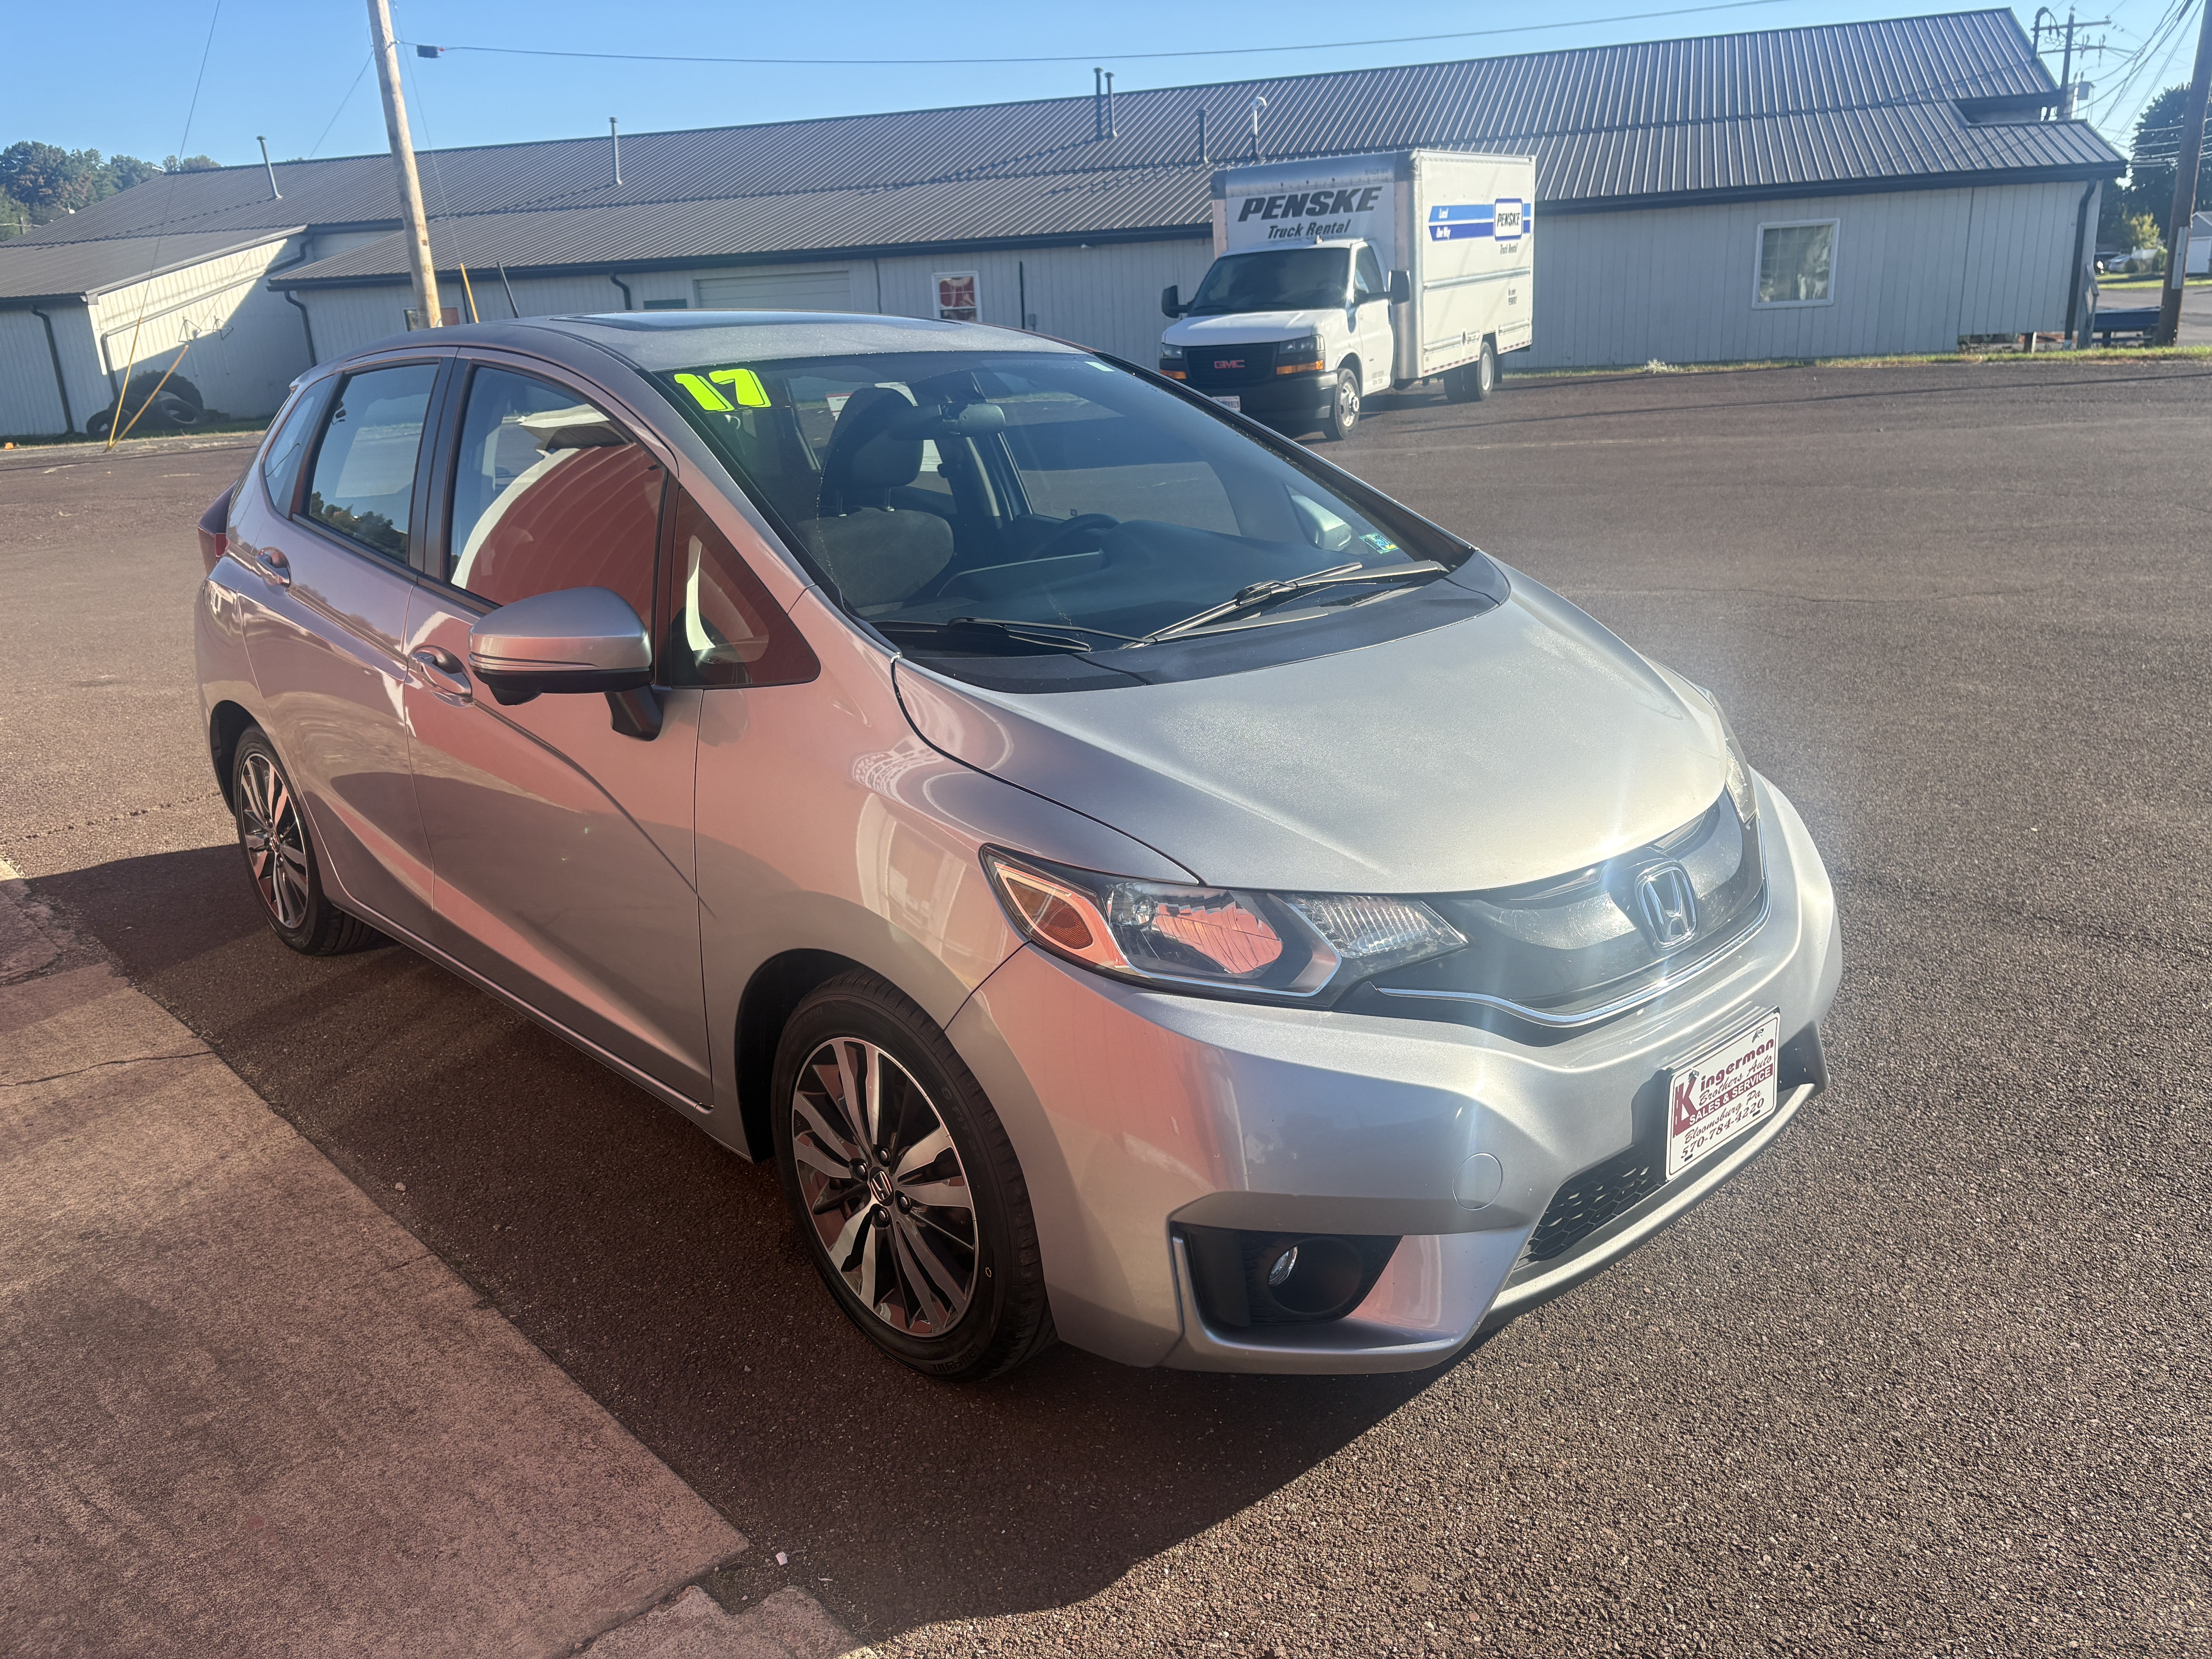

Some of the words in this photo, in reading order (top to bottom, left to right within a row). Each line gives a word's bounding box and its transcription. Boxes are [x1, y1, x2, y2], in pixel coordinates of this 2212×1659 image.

[1238, 186, 1383, 222] PENSKE
[1497, 213, 1521, 227] PENSKE
[1268, 223, 1304, 239] Truck
[1306, 219, 1352, 236] Rental
[1214, 360, 1245, 369] GMC
[674, 369, 771, 412] 17
[1673, 1039, 1774, 1138] Kingerman
[1689, 1097, 1721, 1125] SALES
[1723, 1093, 1729, 1103] &
[1732, 1066, 1771, 1097] SERVICE
[1699, 1074, 1743, 1106] Brothers
[1747, 1055, 1772, 1077] Auto
[1681, 1097, 1764, 1159] 570-784-4220
[1684, 1102, 1742, 1144] Bloomsburg
[1747, 1089, 1762, 1103] Pa
